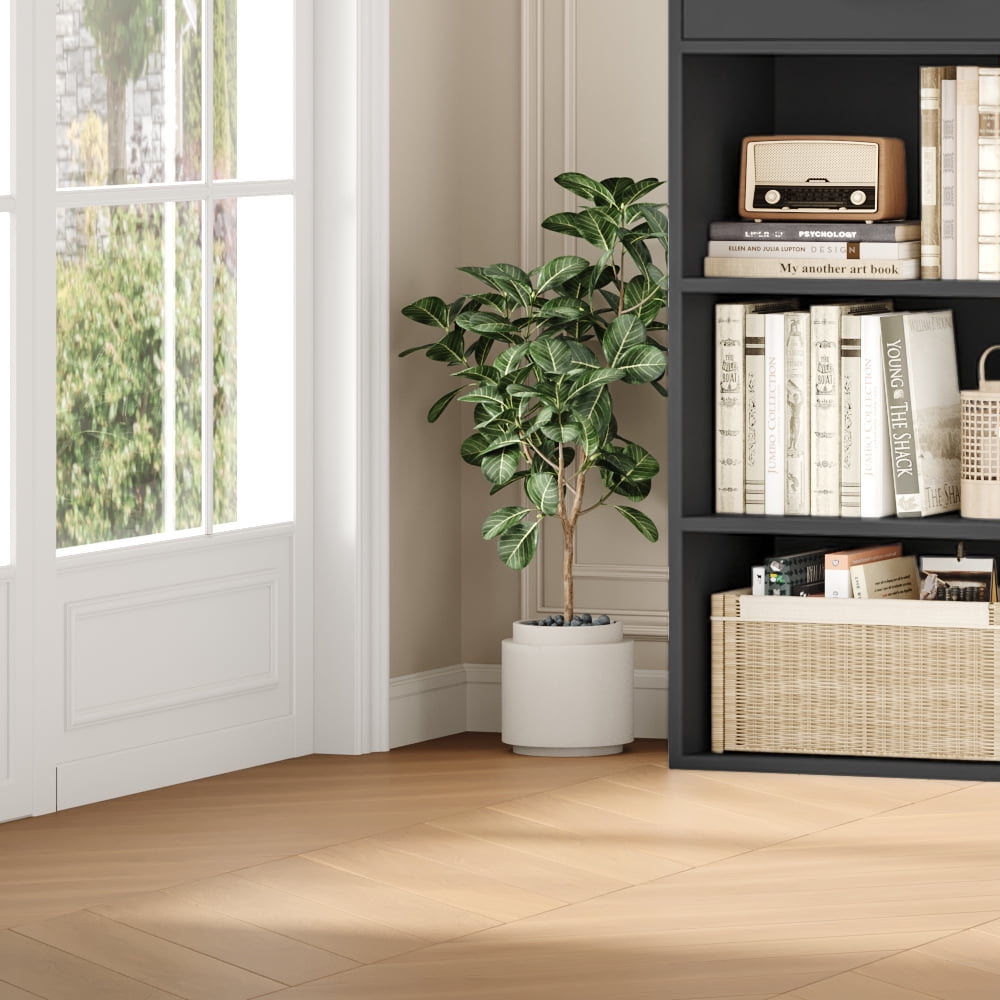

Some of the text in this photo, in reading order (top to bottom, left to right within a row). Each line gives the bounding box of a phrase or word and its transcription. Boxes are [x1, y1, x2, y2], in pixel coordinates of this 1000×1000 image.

[779, 263, 899, 275] My another art book
[767, 356, 777, 474] JUMBO COLLECTION
[886, 339, 913, 478] YOUNG THE SHACK
[925, 483, 961, 508] THE SHA
